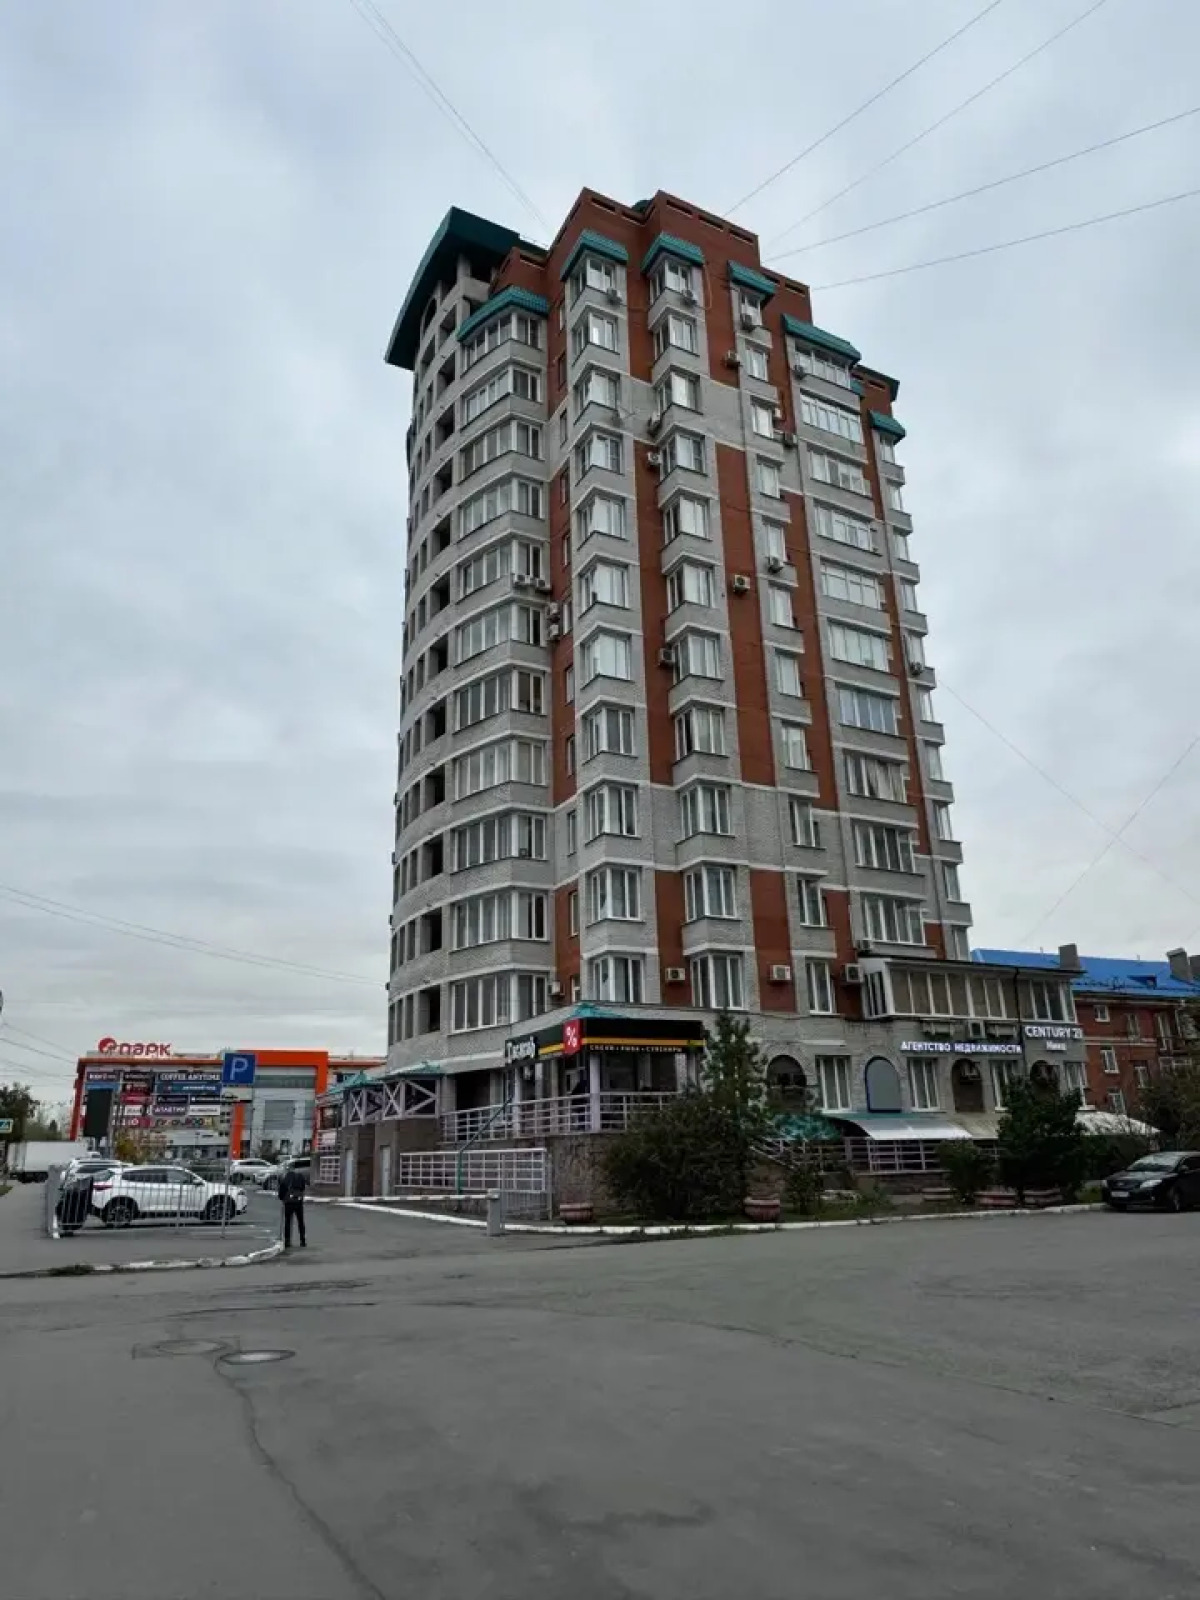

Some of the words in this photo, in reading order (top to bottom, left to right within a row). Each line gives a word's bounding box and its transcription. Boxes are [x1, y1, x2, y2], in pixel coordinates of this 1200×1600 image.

[1025, 1026, 1070, 1038] CENTURY
[1071, 1027, 1083, 1039] 21
[900, 1041, 951, 1052] АГЕНТСТВО
[954, 1043, 1022, 1054] НЕДВИЖИМОСТИ
[230, 1057, 249, 1081] P
